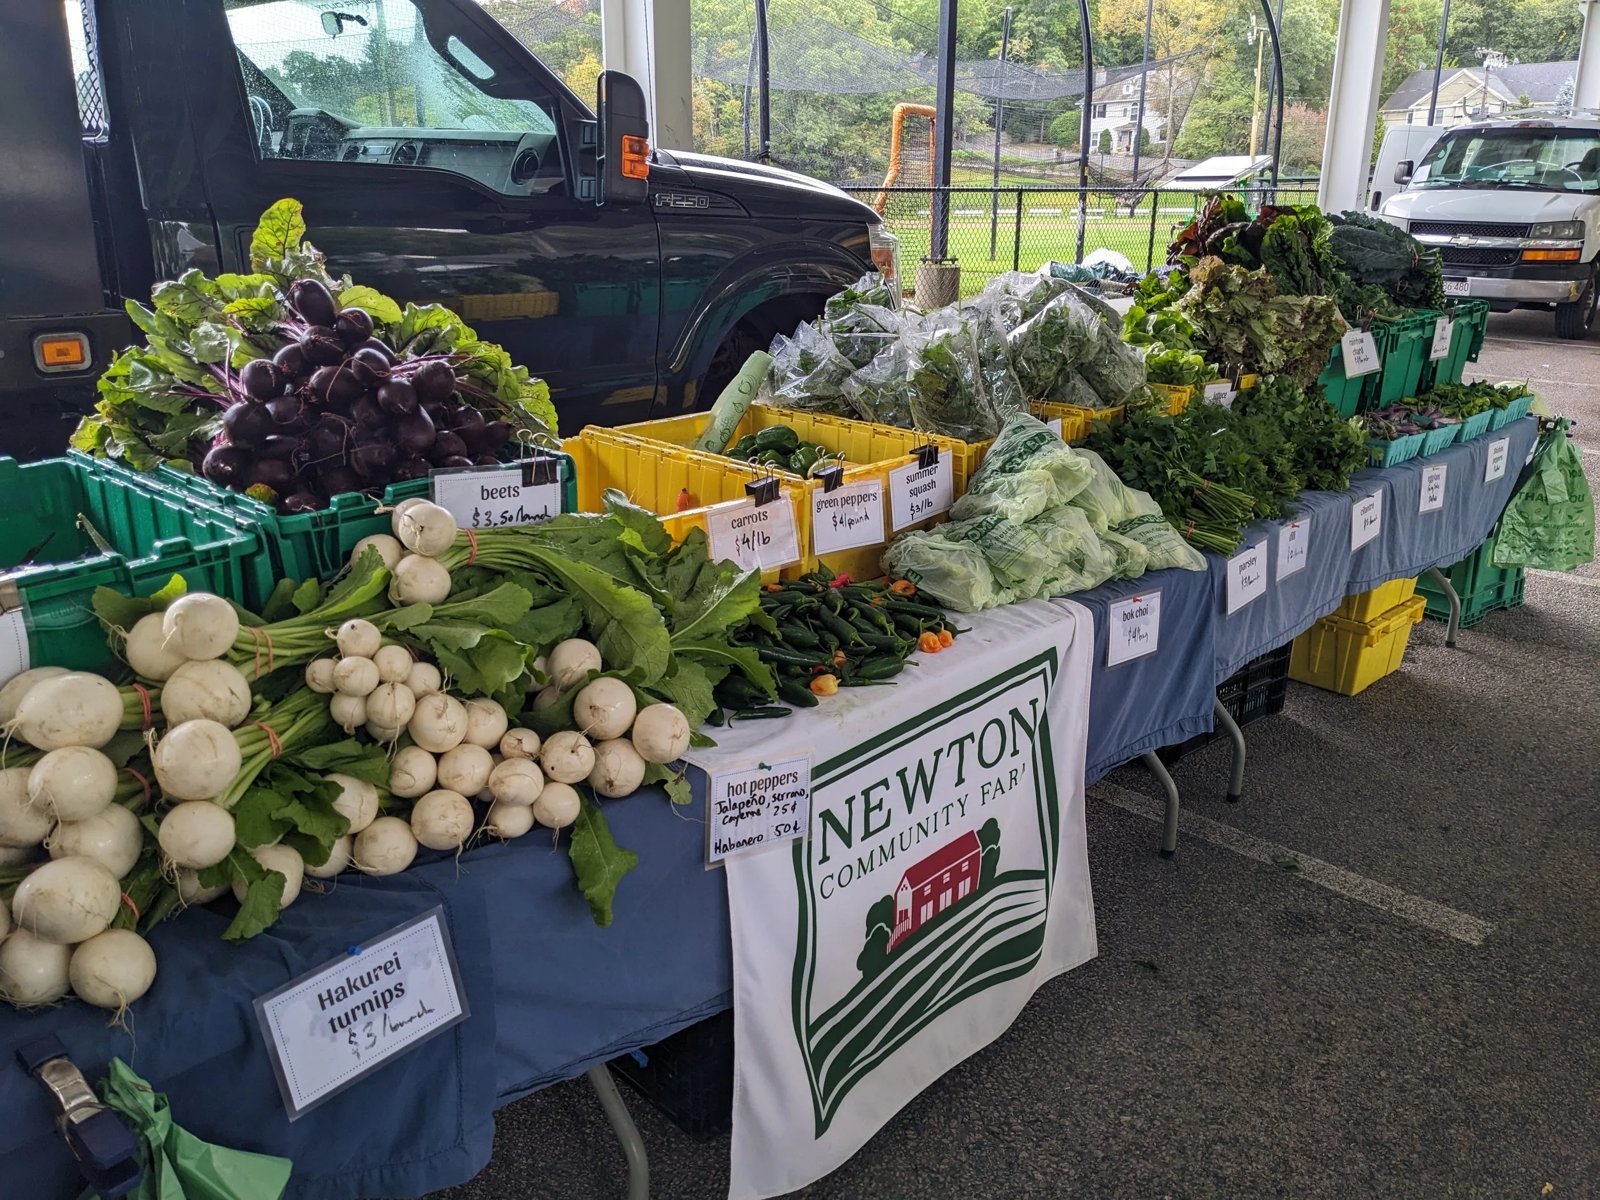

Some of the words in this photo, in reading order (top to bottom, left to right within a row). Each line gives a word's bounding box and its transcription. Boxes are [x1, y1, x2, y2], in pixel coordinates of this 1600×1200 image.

[906, 465, 939, 485] summer
[481, 485, 520, 500] beets
[909, 480, 937, 498] squash
[816, 497, 839, 513] green
[840, 492, 878, 508] peppers
[910, 499, 933, 521] $3/lb
[731, 509, 768, 529] carrots
[832, 509, 870, 531] $4/pound
[735, 530, 771, 556] $4/lb
[1239, 556, 1257, 575] parsley
[1122, 608, 1134, 622] bok
[1135, 604, 1149, 618] choi
[727, 781, 748, 797] hot
[750, 771, 798, 795] peppers
[818, 698, 1038, 865] NEWTON
[714, 834, 763, 854] Habanero
[775, 820, 800, 837] 50¢
[820, 794, 968, 900] COMMUNITY
[317, 952, 402, 1011] Hakurei
[328, 981, 405, 1034] turnips
